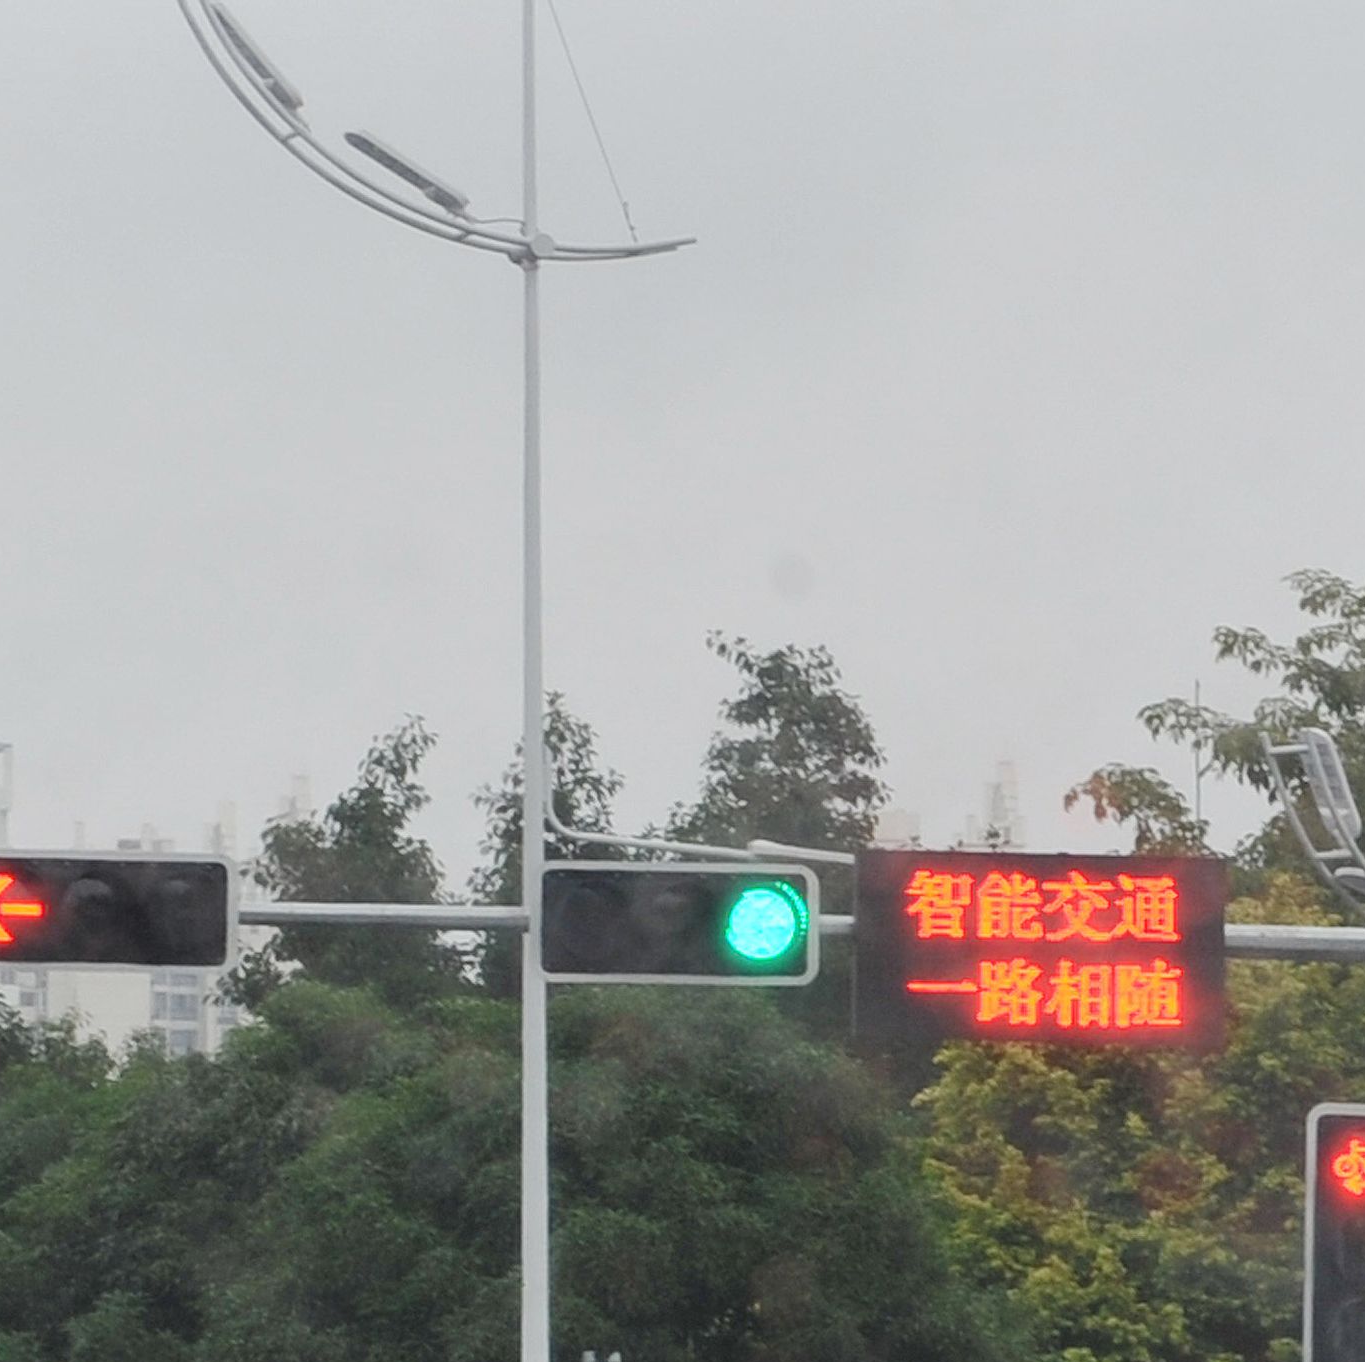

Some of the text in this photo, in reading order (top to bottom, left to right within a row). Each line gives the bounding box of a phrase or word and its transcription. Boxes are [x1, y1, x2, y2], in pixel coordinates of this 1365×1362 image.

[905, 869, 1181, 942] 智能交通
[906, 958, 1183, 1028] 一路相随
